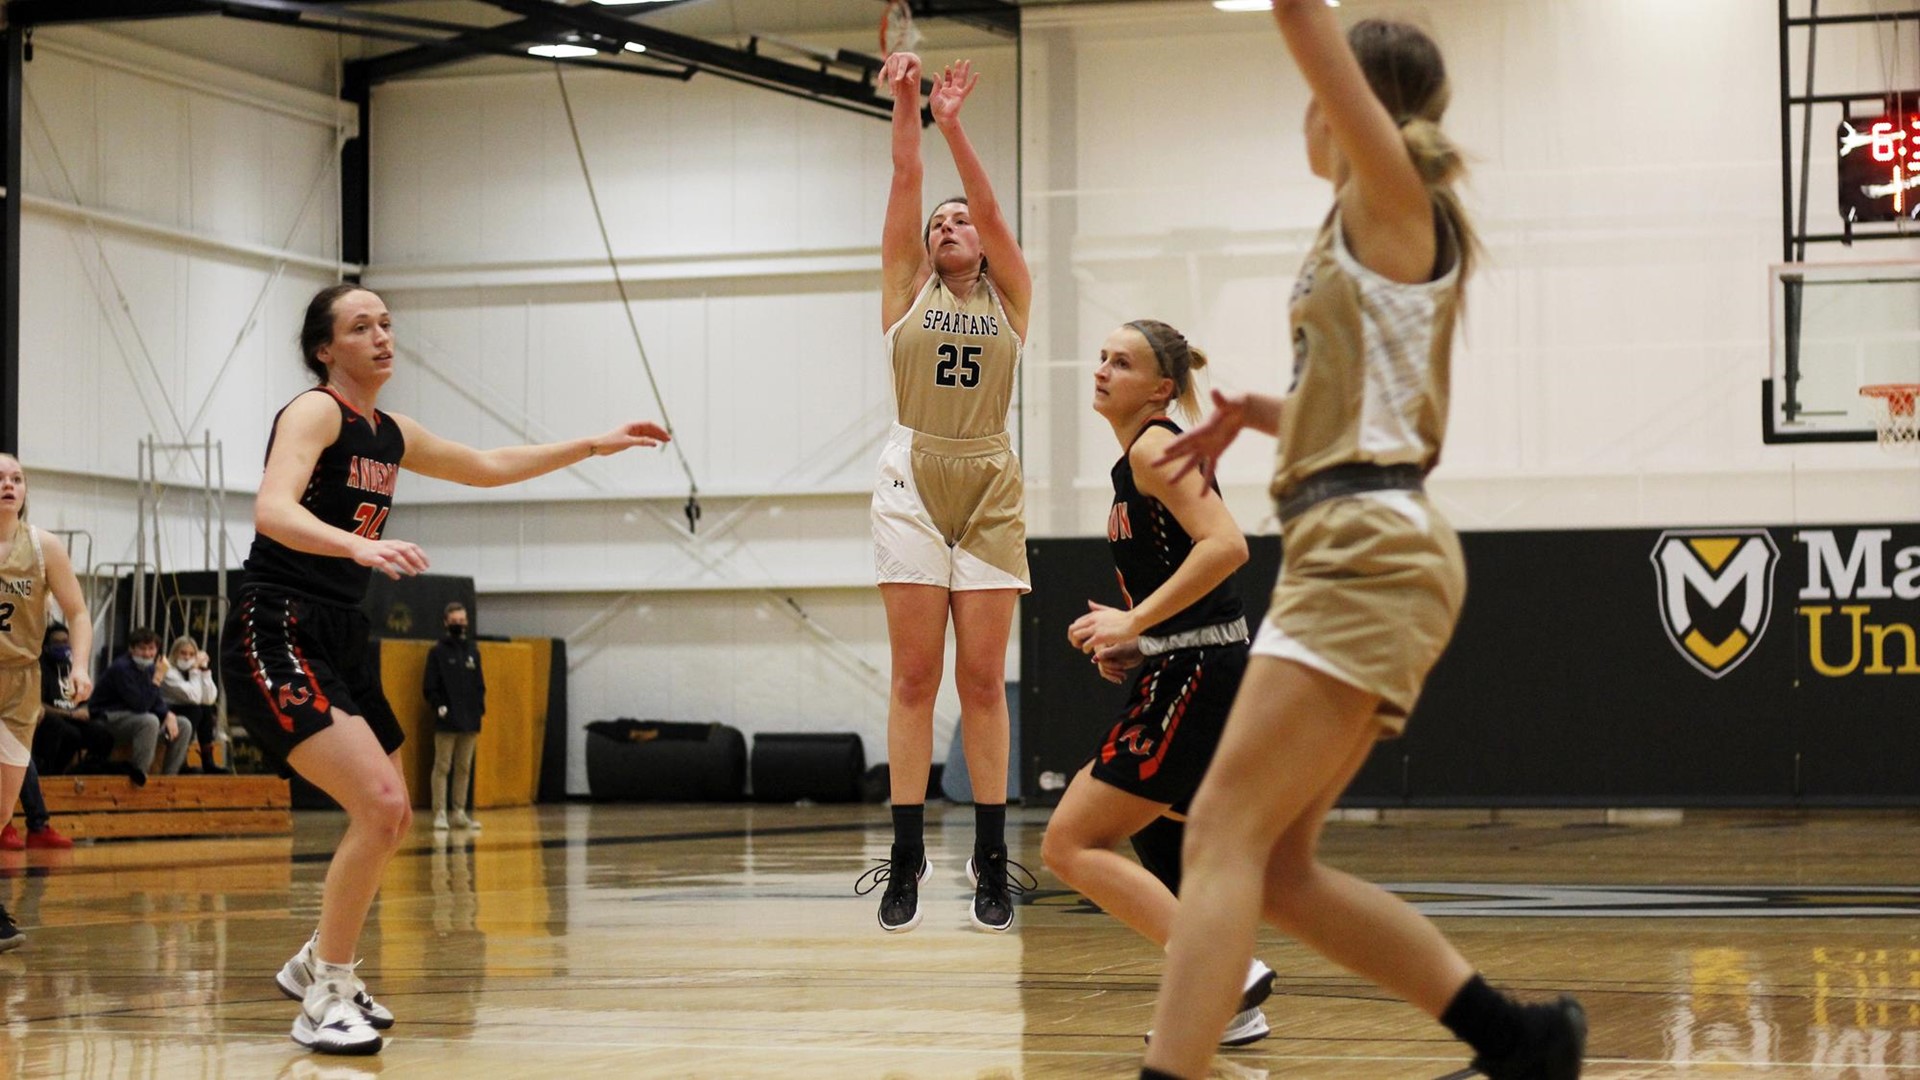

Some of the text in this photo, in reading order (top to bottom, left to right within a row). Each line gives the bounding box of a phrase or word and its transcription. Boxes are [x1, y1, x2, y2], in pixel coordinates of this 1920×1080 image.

[1872, 121, 1920, 161] 6:
[922, 309, 999, 337] SPARTANS
[936, 343, 982, 389] 25
[1798, 528, 1920, 600] Ma
[1799, 605, 1920, 677] Un
